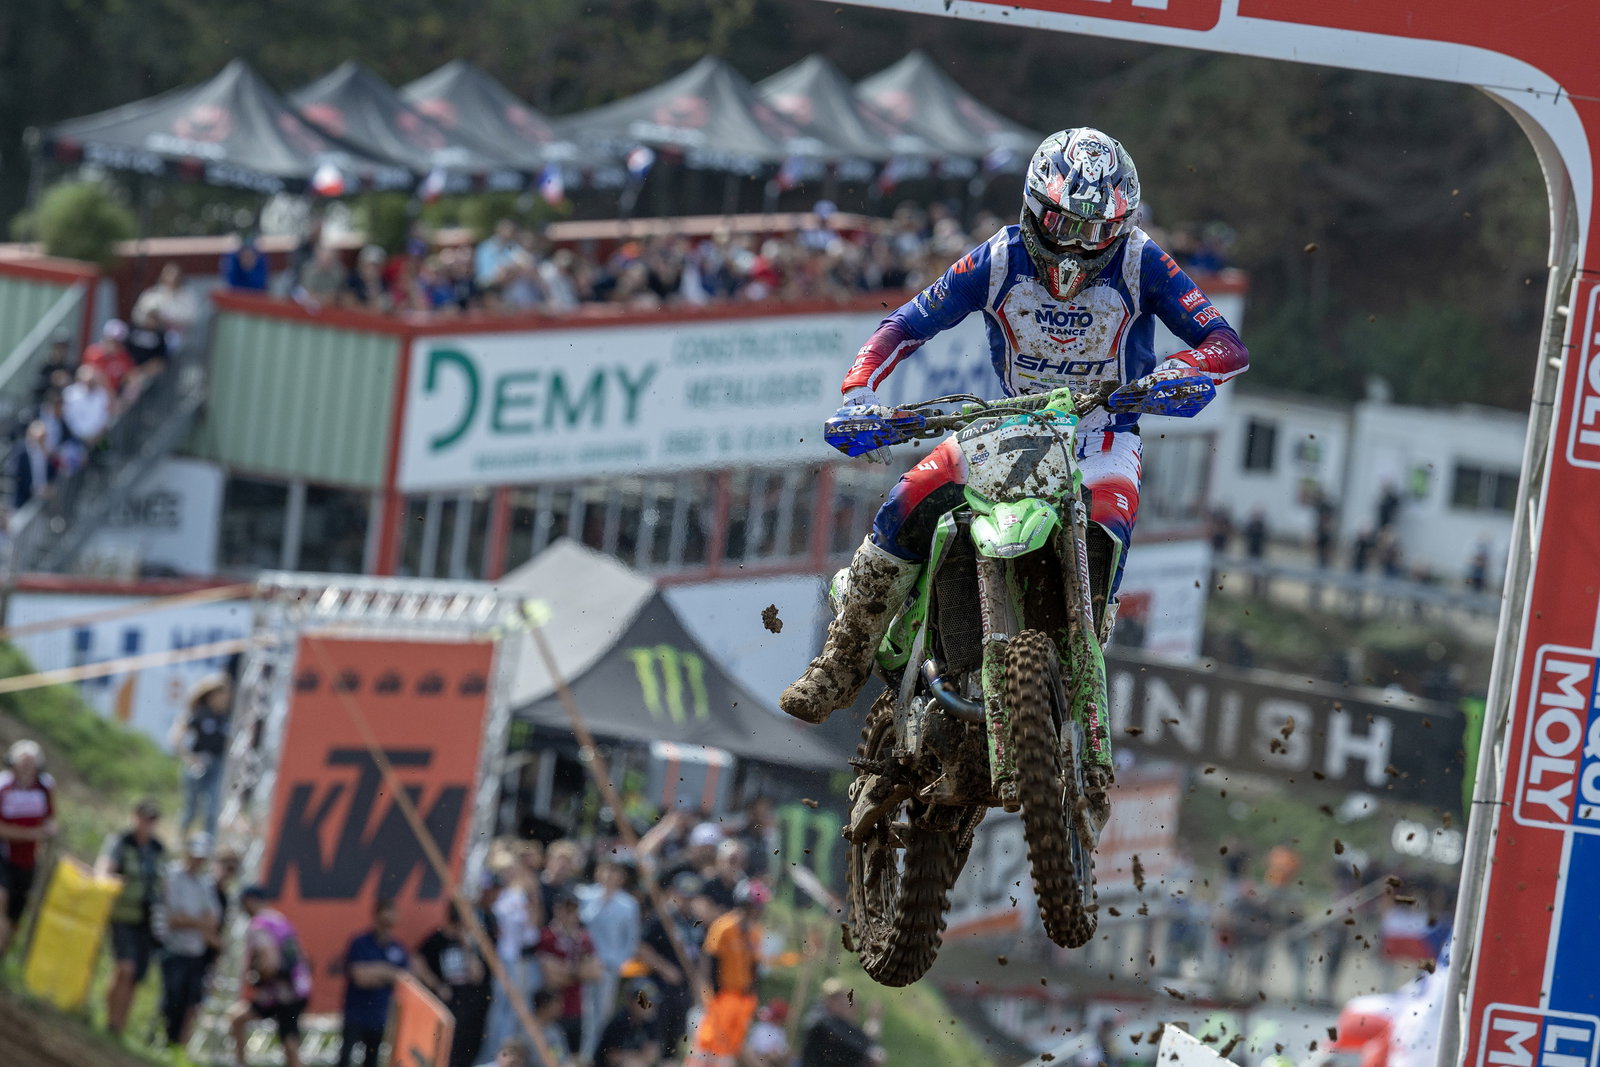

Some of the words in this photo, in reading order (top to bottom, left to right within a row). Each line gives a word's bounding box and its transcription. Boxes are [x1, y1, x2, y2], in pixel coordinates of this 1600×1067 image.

[1182, 289, 1202, 306] NGK
[1035, 309, 1094, 328] MOTO
[1041, 326, 1087, 336] FRANCE
[1014, 353, 1114, 376] SHOT
[425, 347, 659, 453] DEMY
[1154, 384, 1211, 399] ACERBIS
[827, 422, 881, 434] ACERBIS
[998, 435, 1054, 492] 7
[1110, 669, 1393, 788] INISH
[1526, 658, 1591, 823] MOLY
[264, 748, 468, 900] KTM
